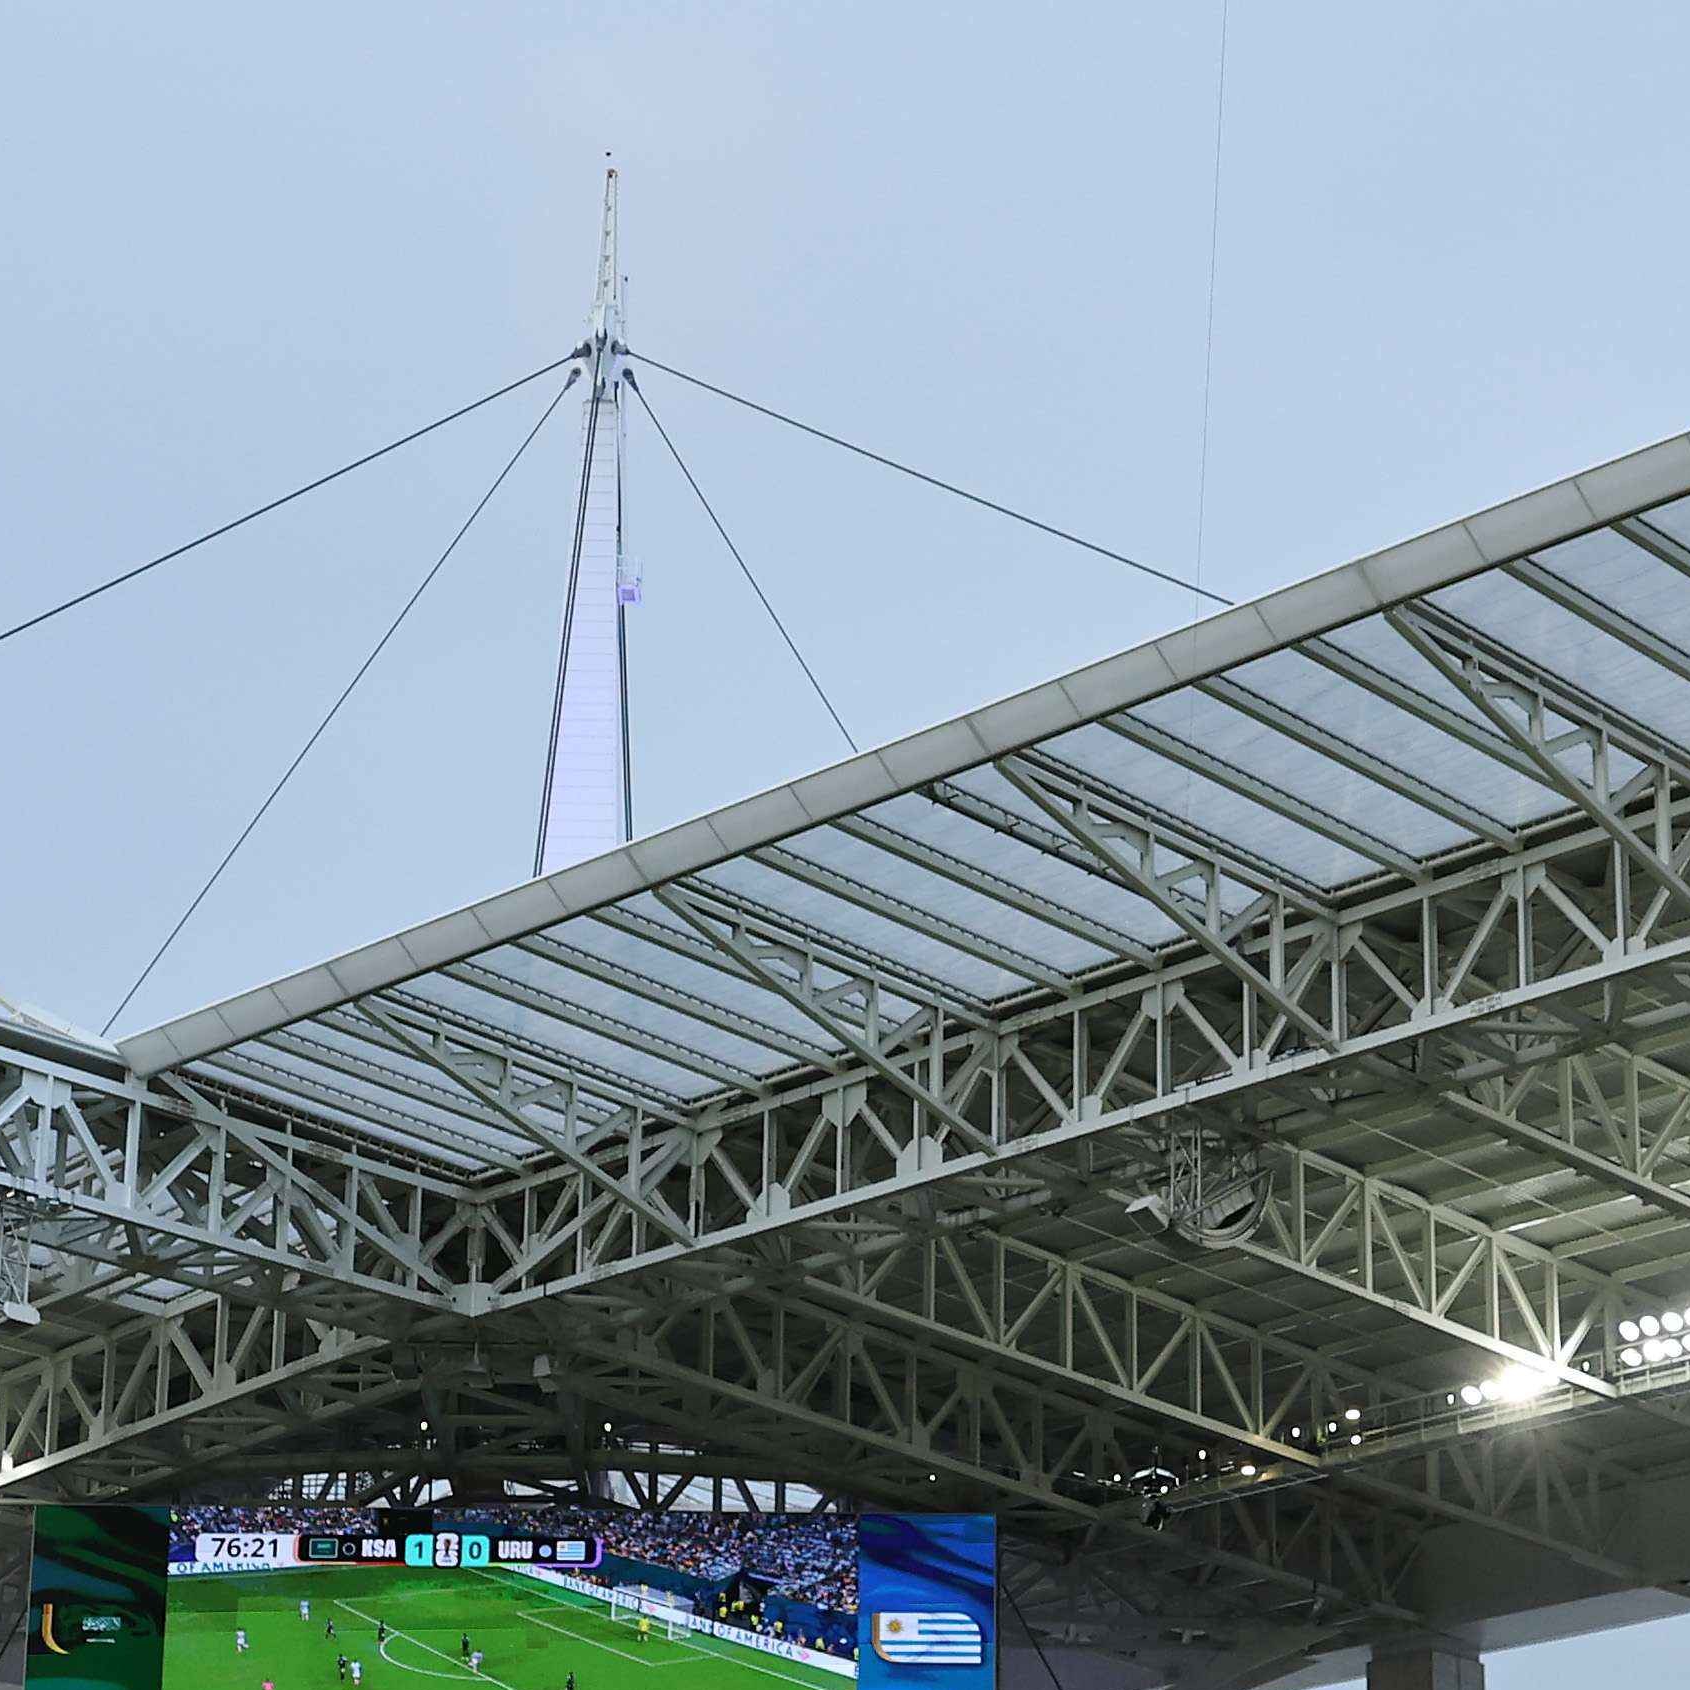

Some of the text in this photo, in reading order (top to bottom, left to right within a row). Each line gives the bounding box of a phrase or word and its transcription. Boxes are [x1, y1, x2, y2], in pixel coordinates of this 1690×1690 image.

[211, 1537, 279, 1558] 76:21
[361, 1539, 397, 1558] KSA
[414, 1541, 424, 1560] 1
[469, 1541, 483, 1560] 0
[498, 1541, 533, 1560] URU
